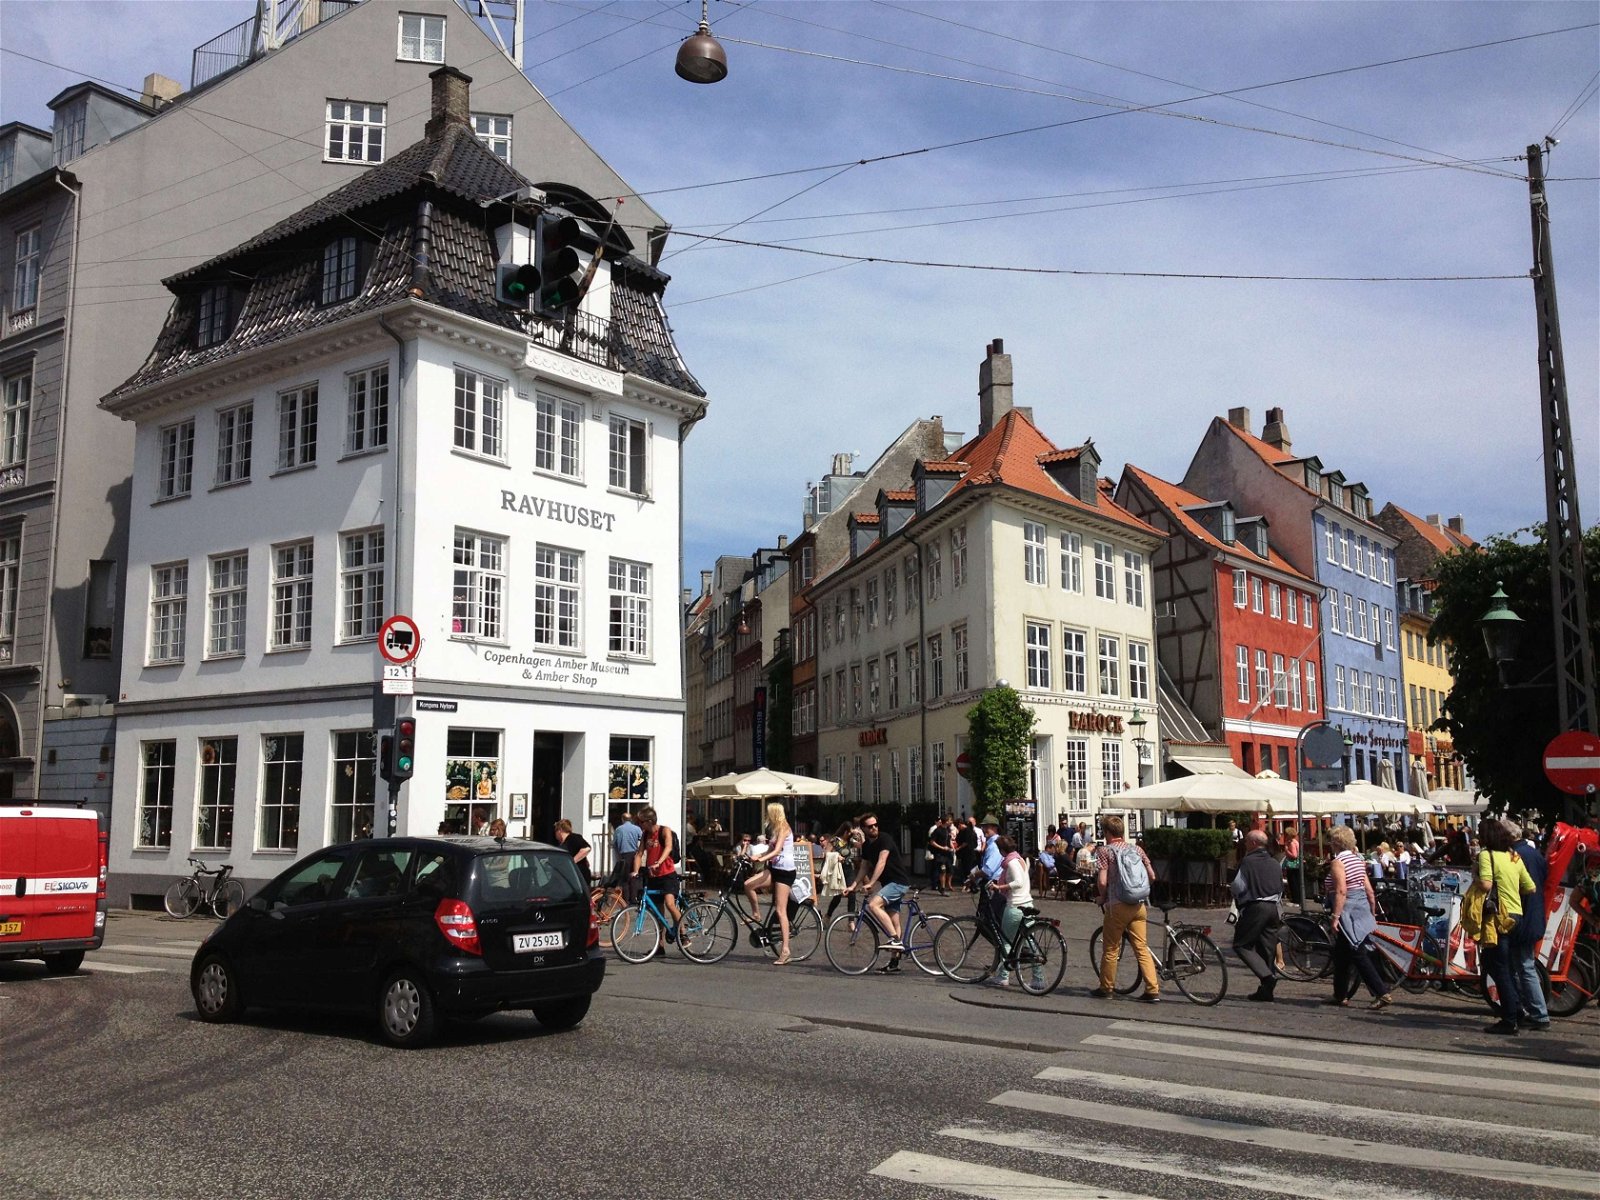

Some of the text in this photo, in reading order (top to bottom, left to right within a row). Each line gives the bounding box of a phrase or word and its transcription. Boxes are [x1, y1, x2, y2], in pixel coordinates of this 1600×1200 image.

[500, 489, 616, 532] RAVHUSET
[484, 650, 630, 676] Copenhagen Amber Museum
[389, 668, 399, 677] 12
[522, 668, 598, 688] & Amber Shop
[420, 701, 439, 709] Kongens
[1068, 710, 1125, 733] BAROCK
[4, 924, 18, 932] 157
[518, 934, 559, 949] ZV 25 923
[533, 955, 545, 963] DK
